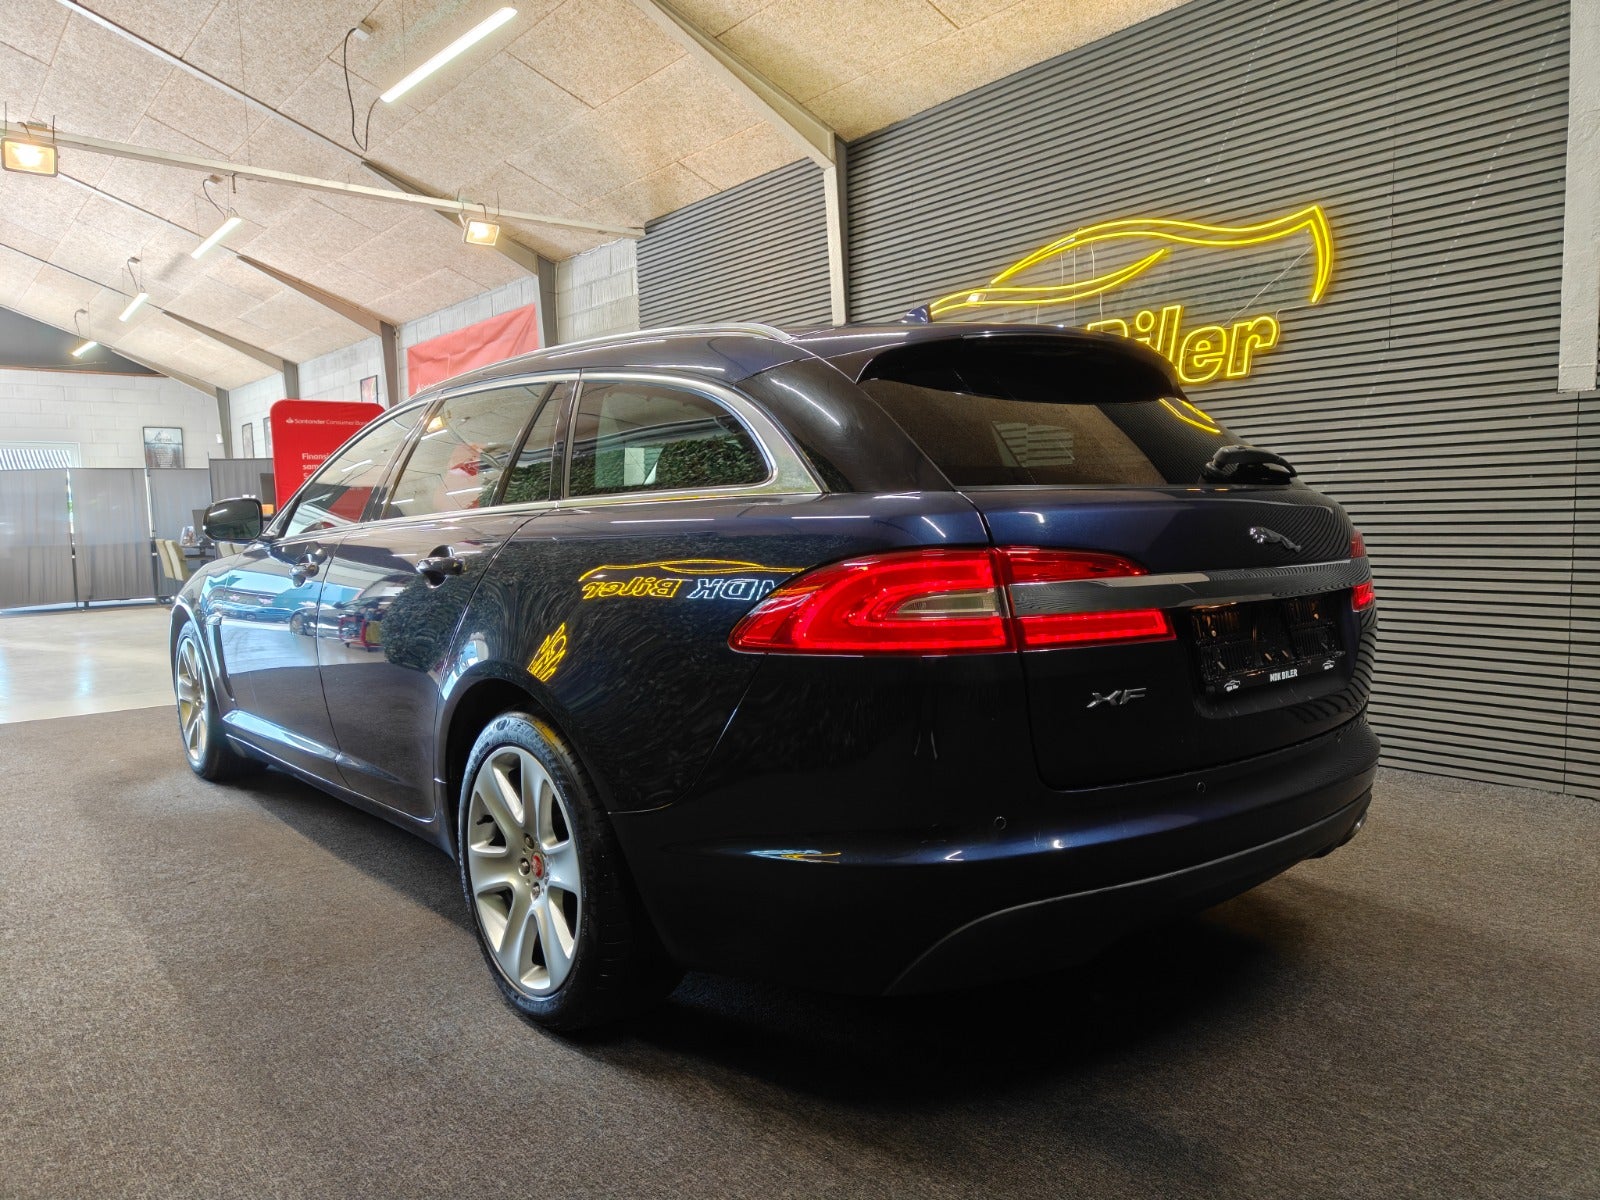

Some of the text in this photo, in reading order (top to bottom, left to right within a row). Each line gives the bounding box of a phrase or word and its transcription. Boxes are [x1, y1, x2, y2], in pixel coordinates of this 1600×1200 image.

[326, 418, 354, 426] Consumer
[301, 452, 330, 460] Finansi
[1086, 687, 1147, 708] XF
